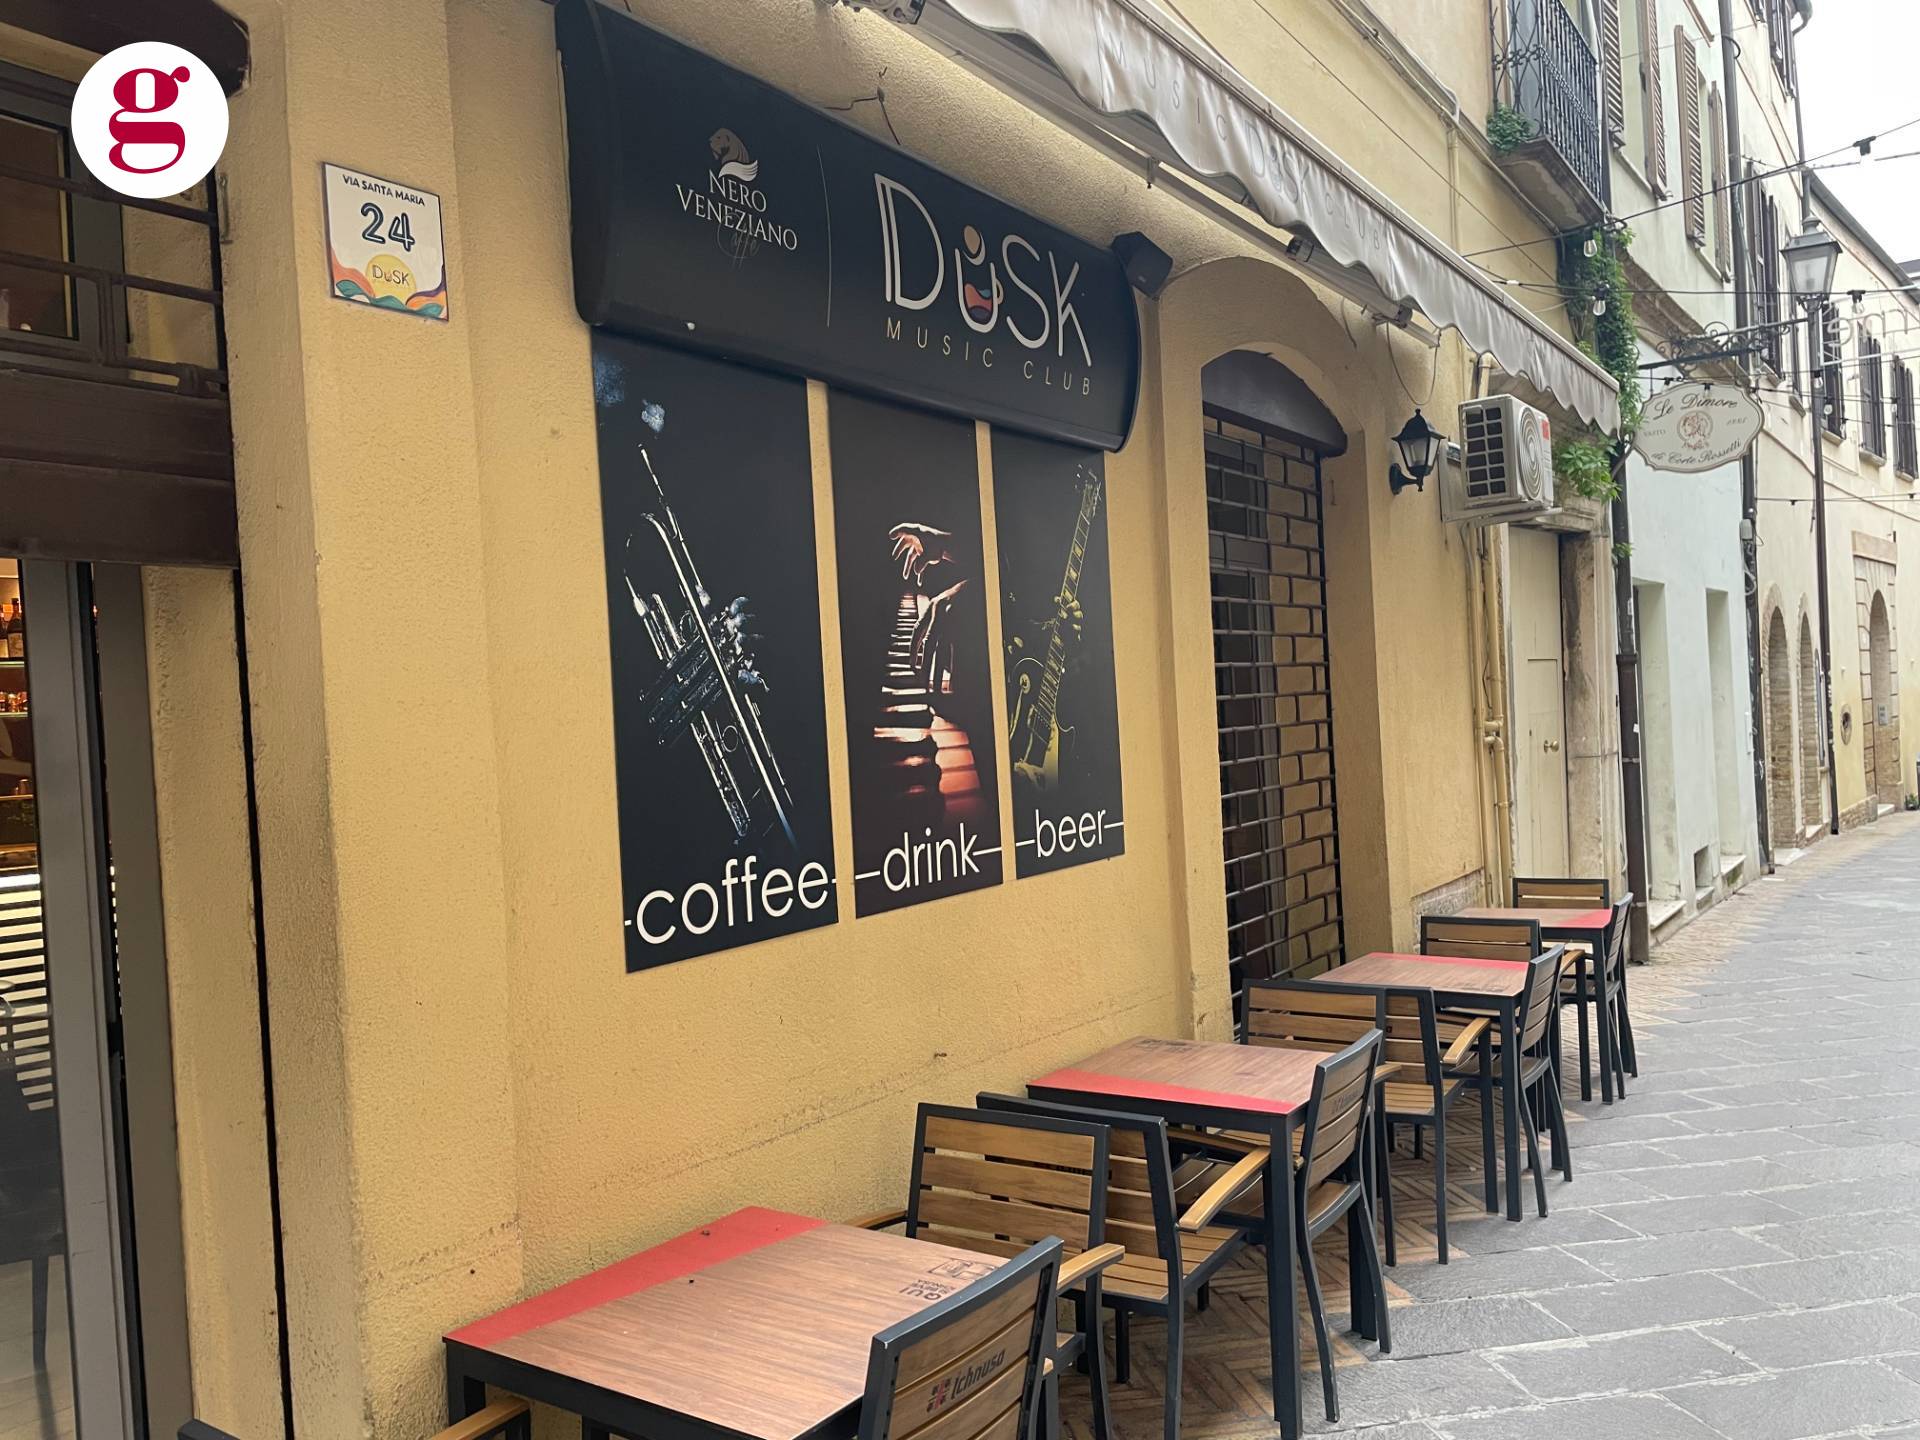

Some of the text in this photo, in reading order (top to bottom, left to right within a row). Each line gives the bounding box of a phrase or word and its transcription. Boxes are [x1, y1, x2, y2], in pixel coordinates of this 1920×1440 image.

[1107, 31, 1228, 142] MUSIC
[1325, 190, 1381, 250] CLUB
[342, 174, 425, 206] VIA SANTA MARIA
[708, 168, 767, 213] NERO
[360, 202, 416, 252] 24
[675, 183, 798, 251] VENEZIANO
[886, 316, 1090, 396] MUSIC CLUB
[1653, 393, 1738, 420] Le Dimore
[1699, 437, 1741, 463] Rossetti
[951, 1349, 1006, 1400] Ichnusa
